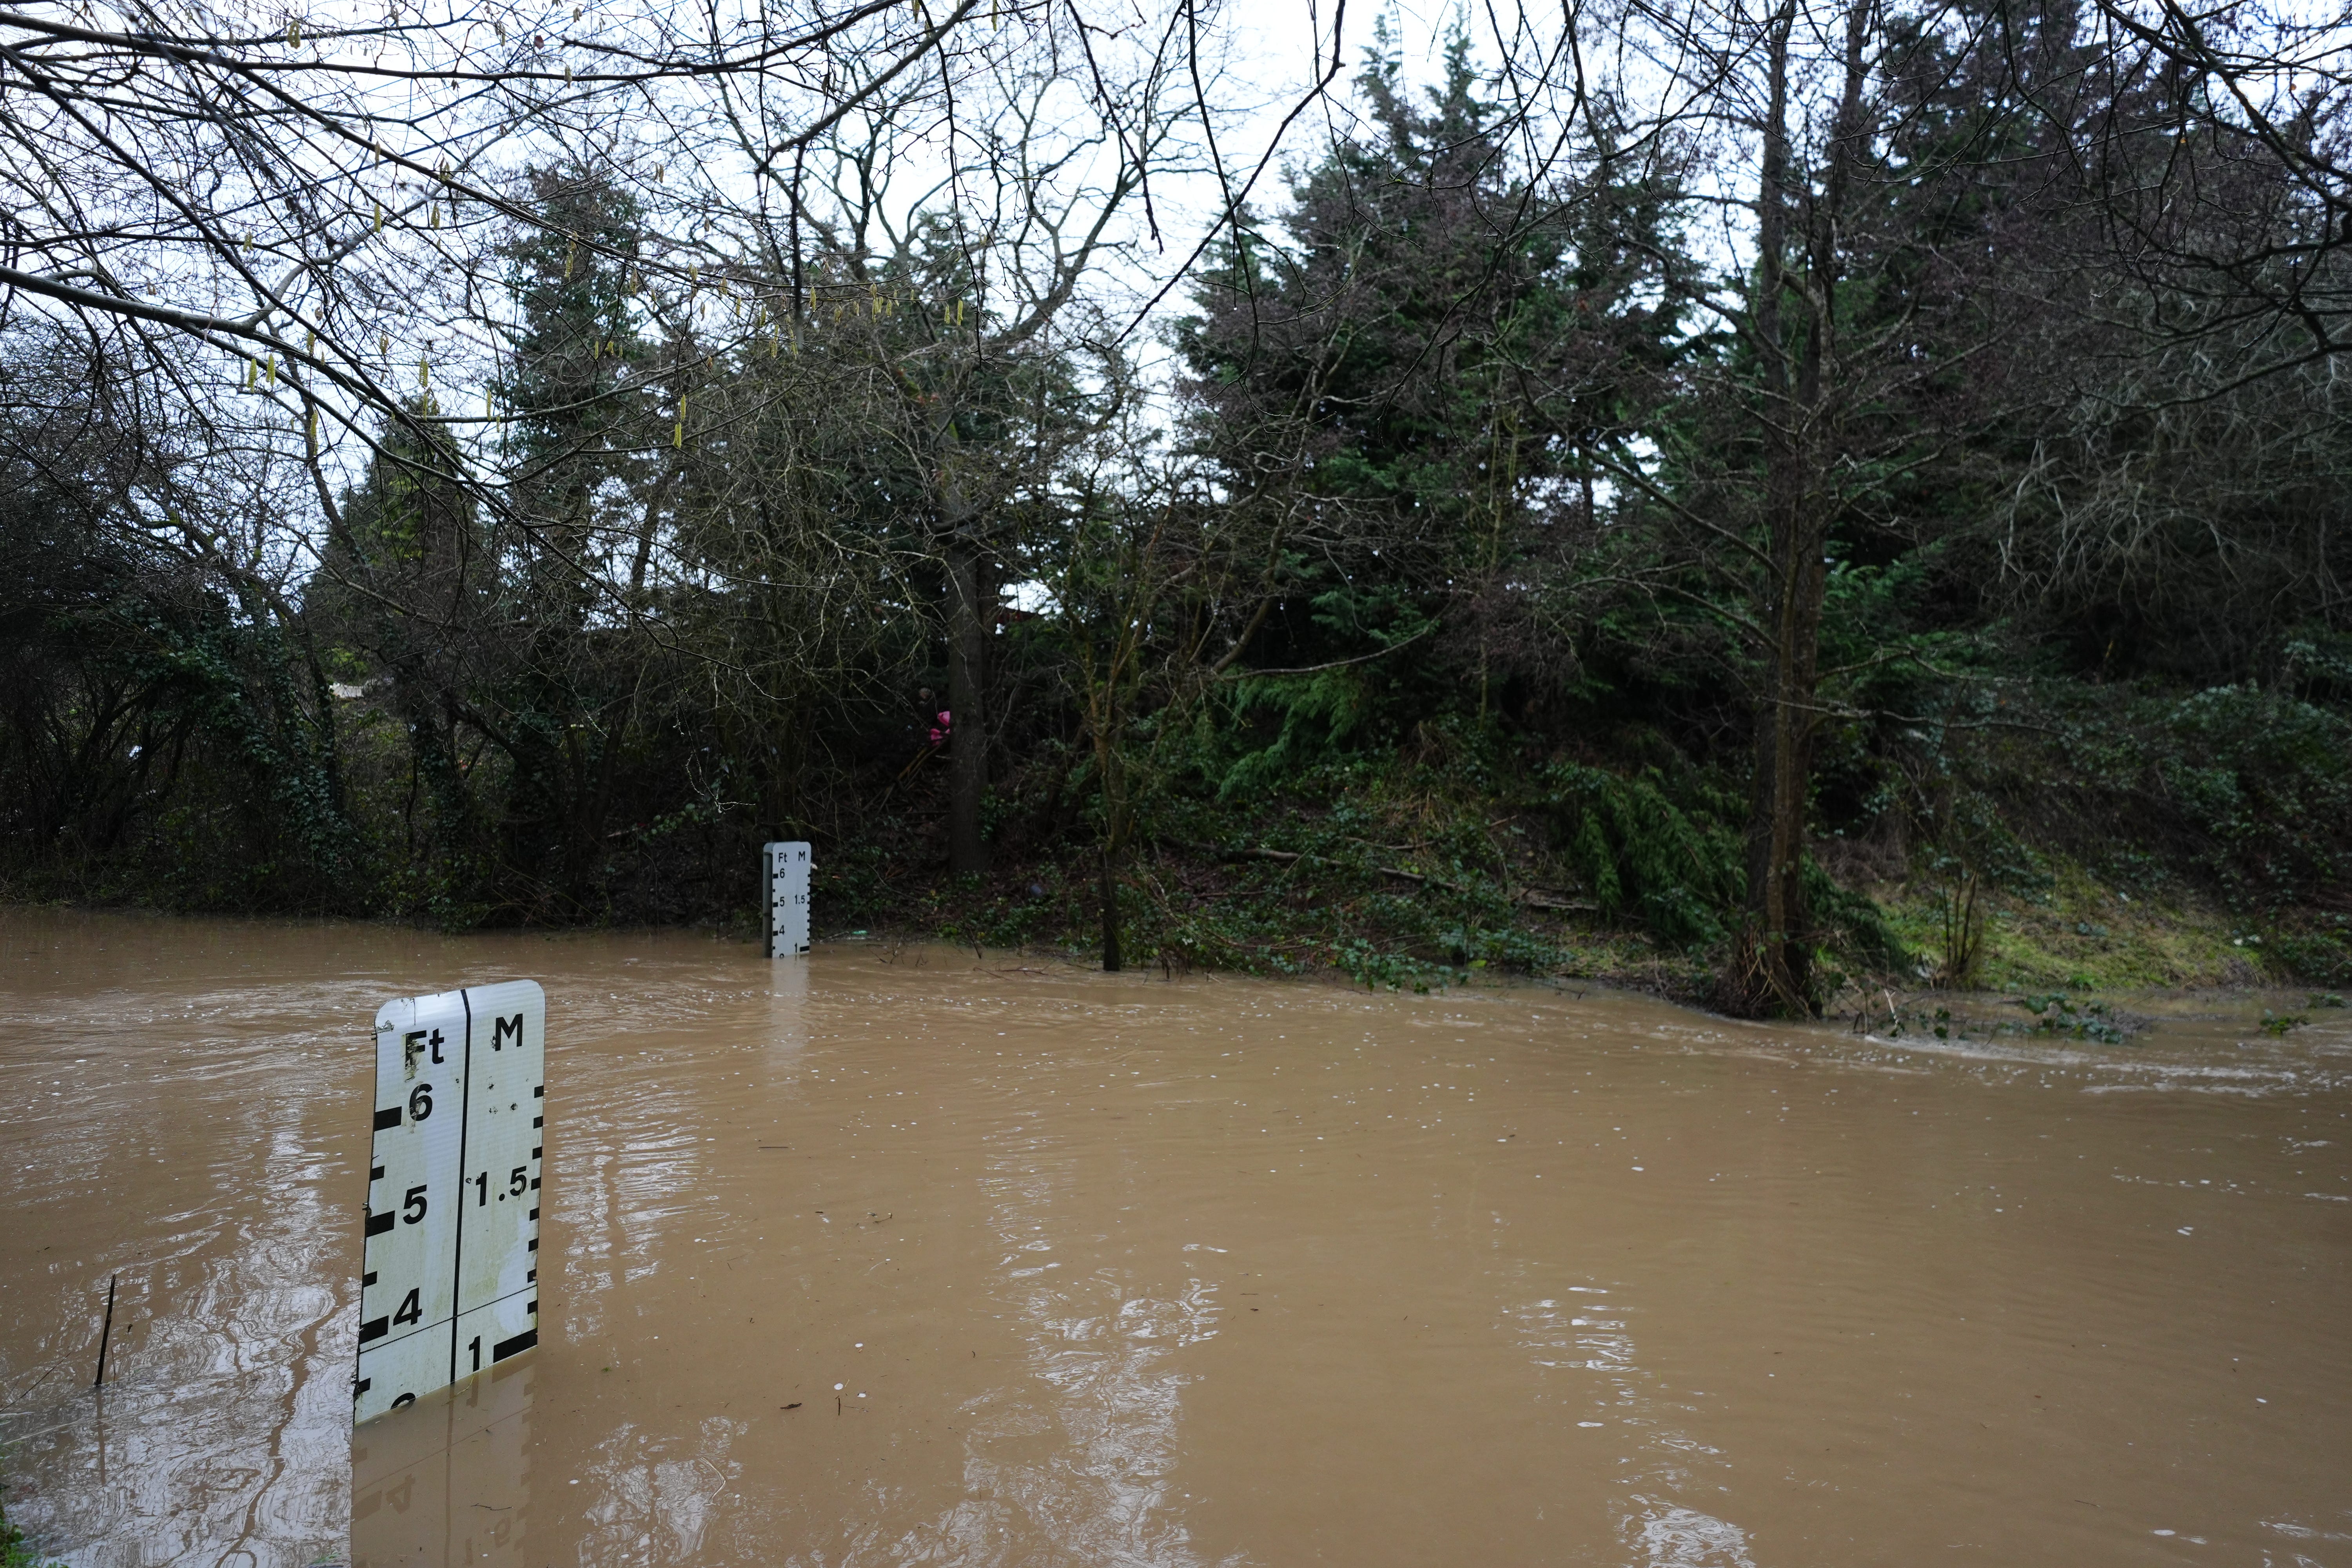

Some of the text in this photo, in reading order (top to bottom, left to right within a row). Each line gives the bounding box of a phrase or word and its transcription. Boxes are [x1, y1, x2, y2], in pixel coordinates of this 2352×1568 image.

[778, 852, 787, 862] Ft
[798, 851, 805, 862] M
[779, 868, 785, 878] 6
[779, 897, 785, 907] 5
[795, 894, 805, 905] 1.5
[779, 925, 785, 935] 4
[795, 942, 798, 953] 1
[495, 1013, 523, 1051] M
[405, 1028, 445, 1068] Ft
[409, 1083, 433, 1121] 6
[475, 1166, 527, 1207] 1.5
[403, 1184, 427, 1225] 5
[393, 1287, 422, 1326] 4
[468, 1335, 481, 1372] 1
